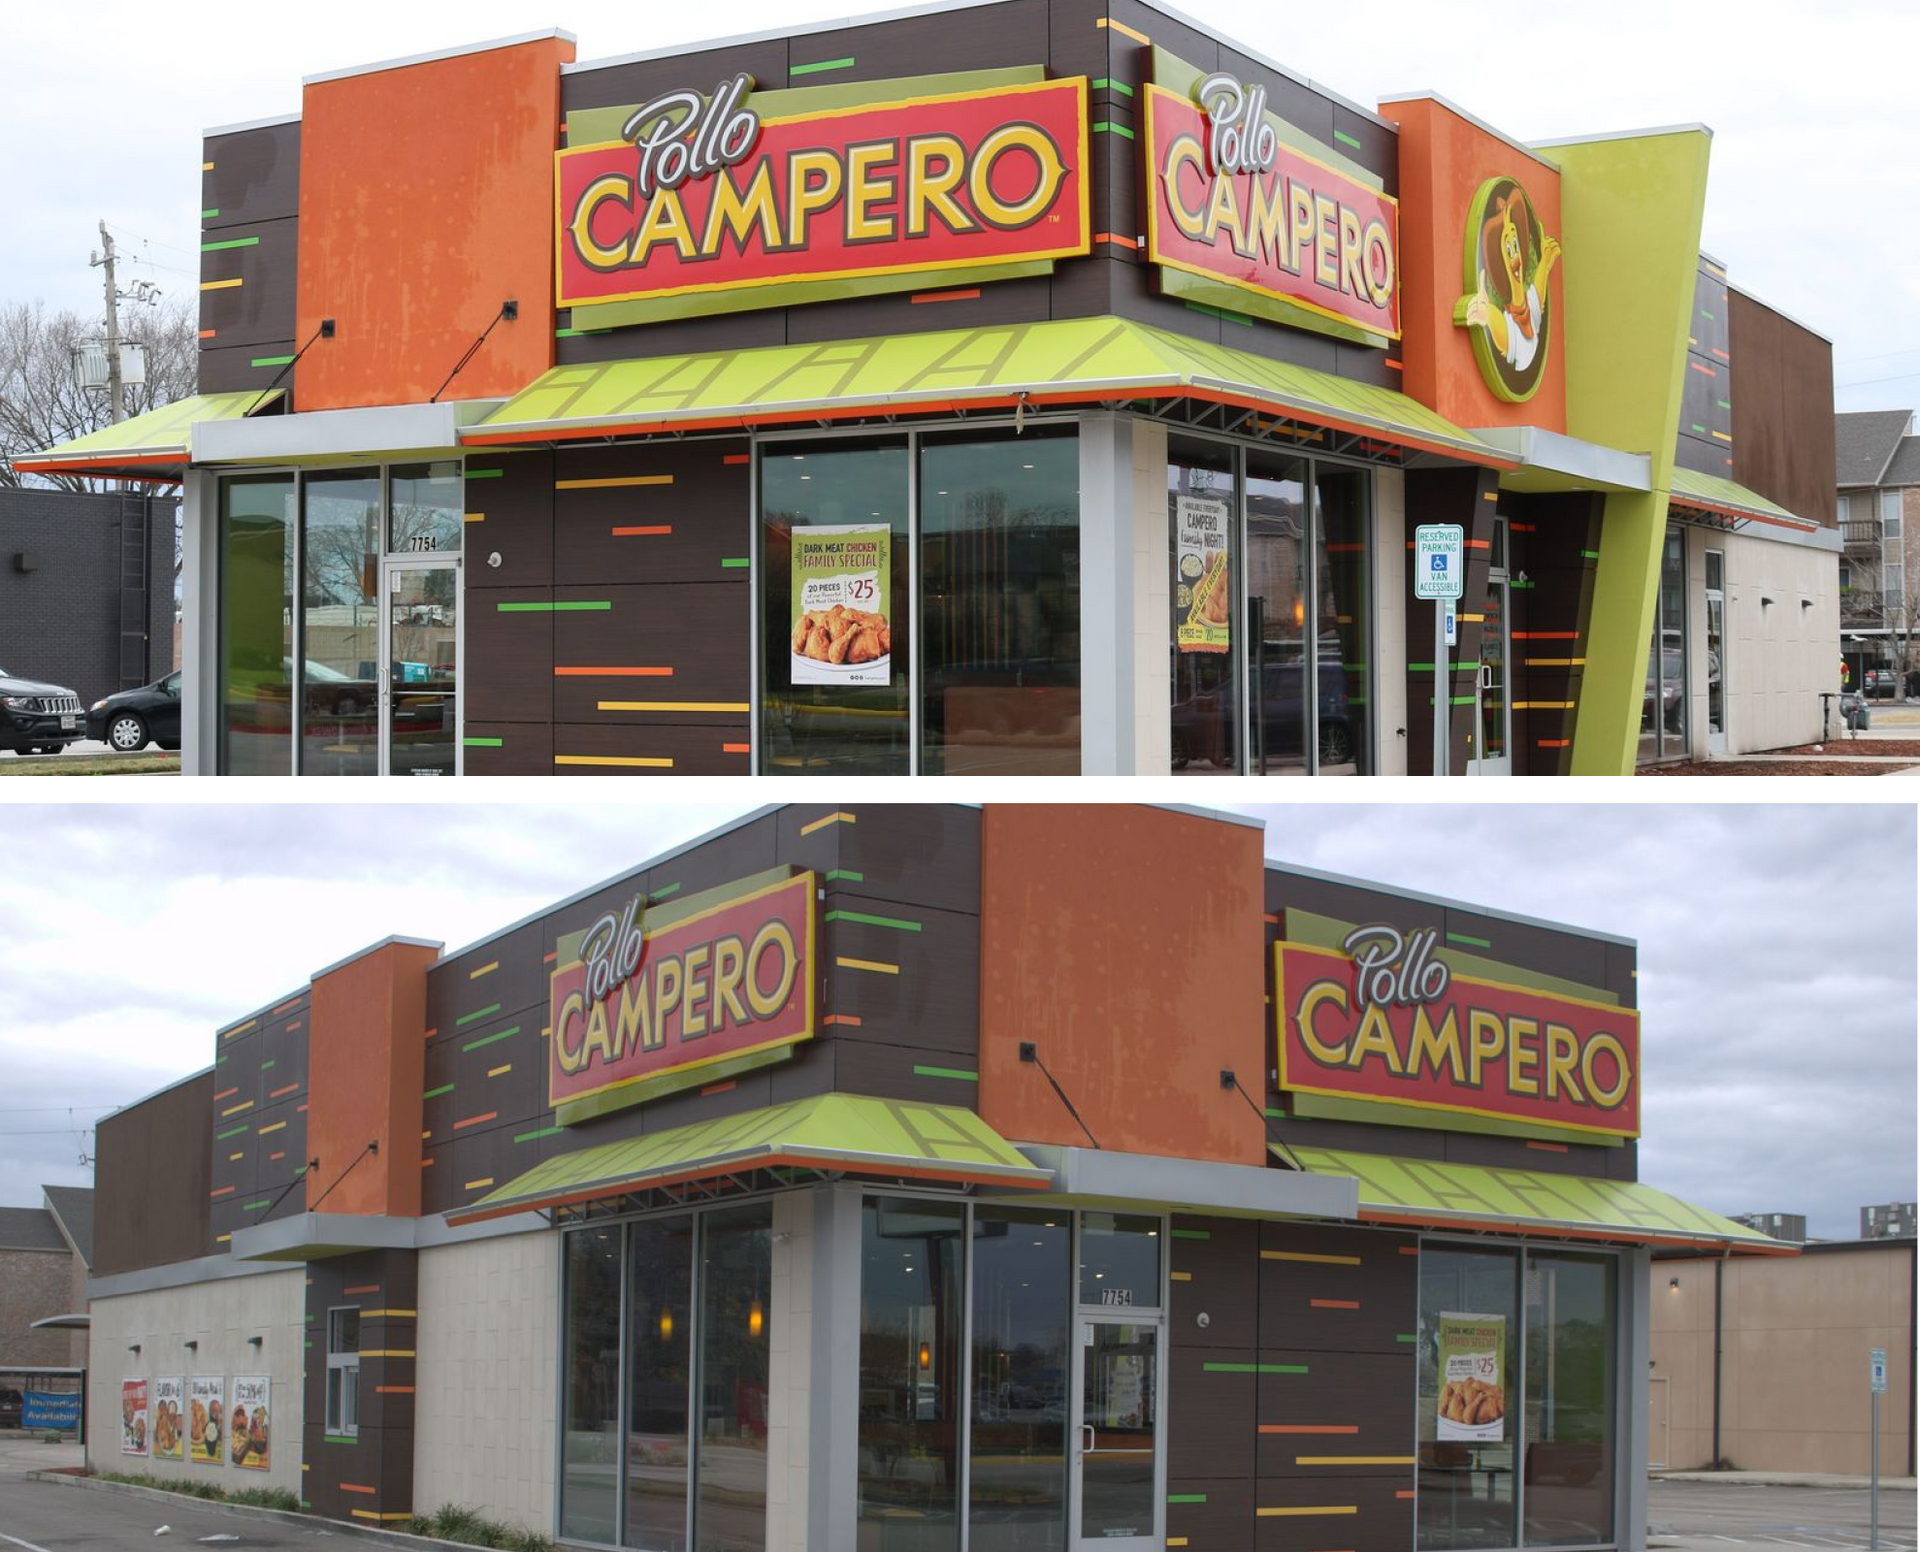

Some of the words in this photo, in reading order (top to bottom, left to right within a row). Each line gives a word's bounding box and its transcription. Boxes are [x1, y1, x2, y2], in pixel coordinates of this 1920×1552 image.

[1198, 74, 1278, 175] Pollo
[623, 73, 758, 195] Pollo
[567, 123, 1069, 271] CAMPERO
[1160, 134, 1395, 309] CAMPERO
[1187, 514, 1218, 531] CAMPERO
[411, 537, 437, 551] 7754
[1181, 529, 1203, 551] family
[1204, 532, 1224, 549] NIGHT!
[1420, 532, 1459, 541] RESERVED
[804, 543, 823, 554] DARK
[825, 543, 845, 554] MEAT
[846, 542, 877, 553] CHICKEN
[1422, 543, 1456, 552] PARKING
[804, 554, 836, 568] FAMILY
[840, 553, 877, 567] SPECIAL
[1431, 572, 1448, 581] VAN
[808, 584, 818, 593] 20
[819, 583, 841, 593] PIECES
[848, 579, 874, 599] $25
[1420, 582, 1458, 592] ACCESSIBLE
[579, 893, 645, 1009] Pollo
[1344, 923, 1450, 1008] Pollo
[556, 918, 801, 1076] CAMPERO
[1292, 979, 1632, 1111] CAMPERO
[1103, 1289, 1131, 1305] 7754
